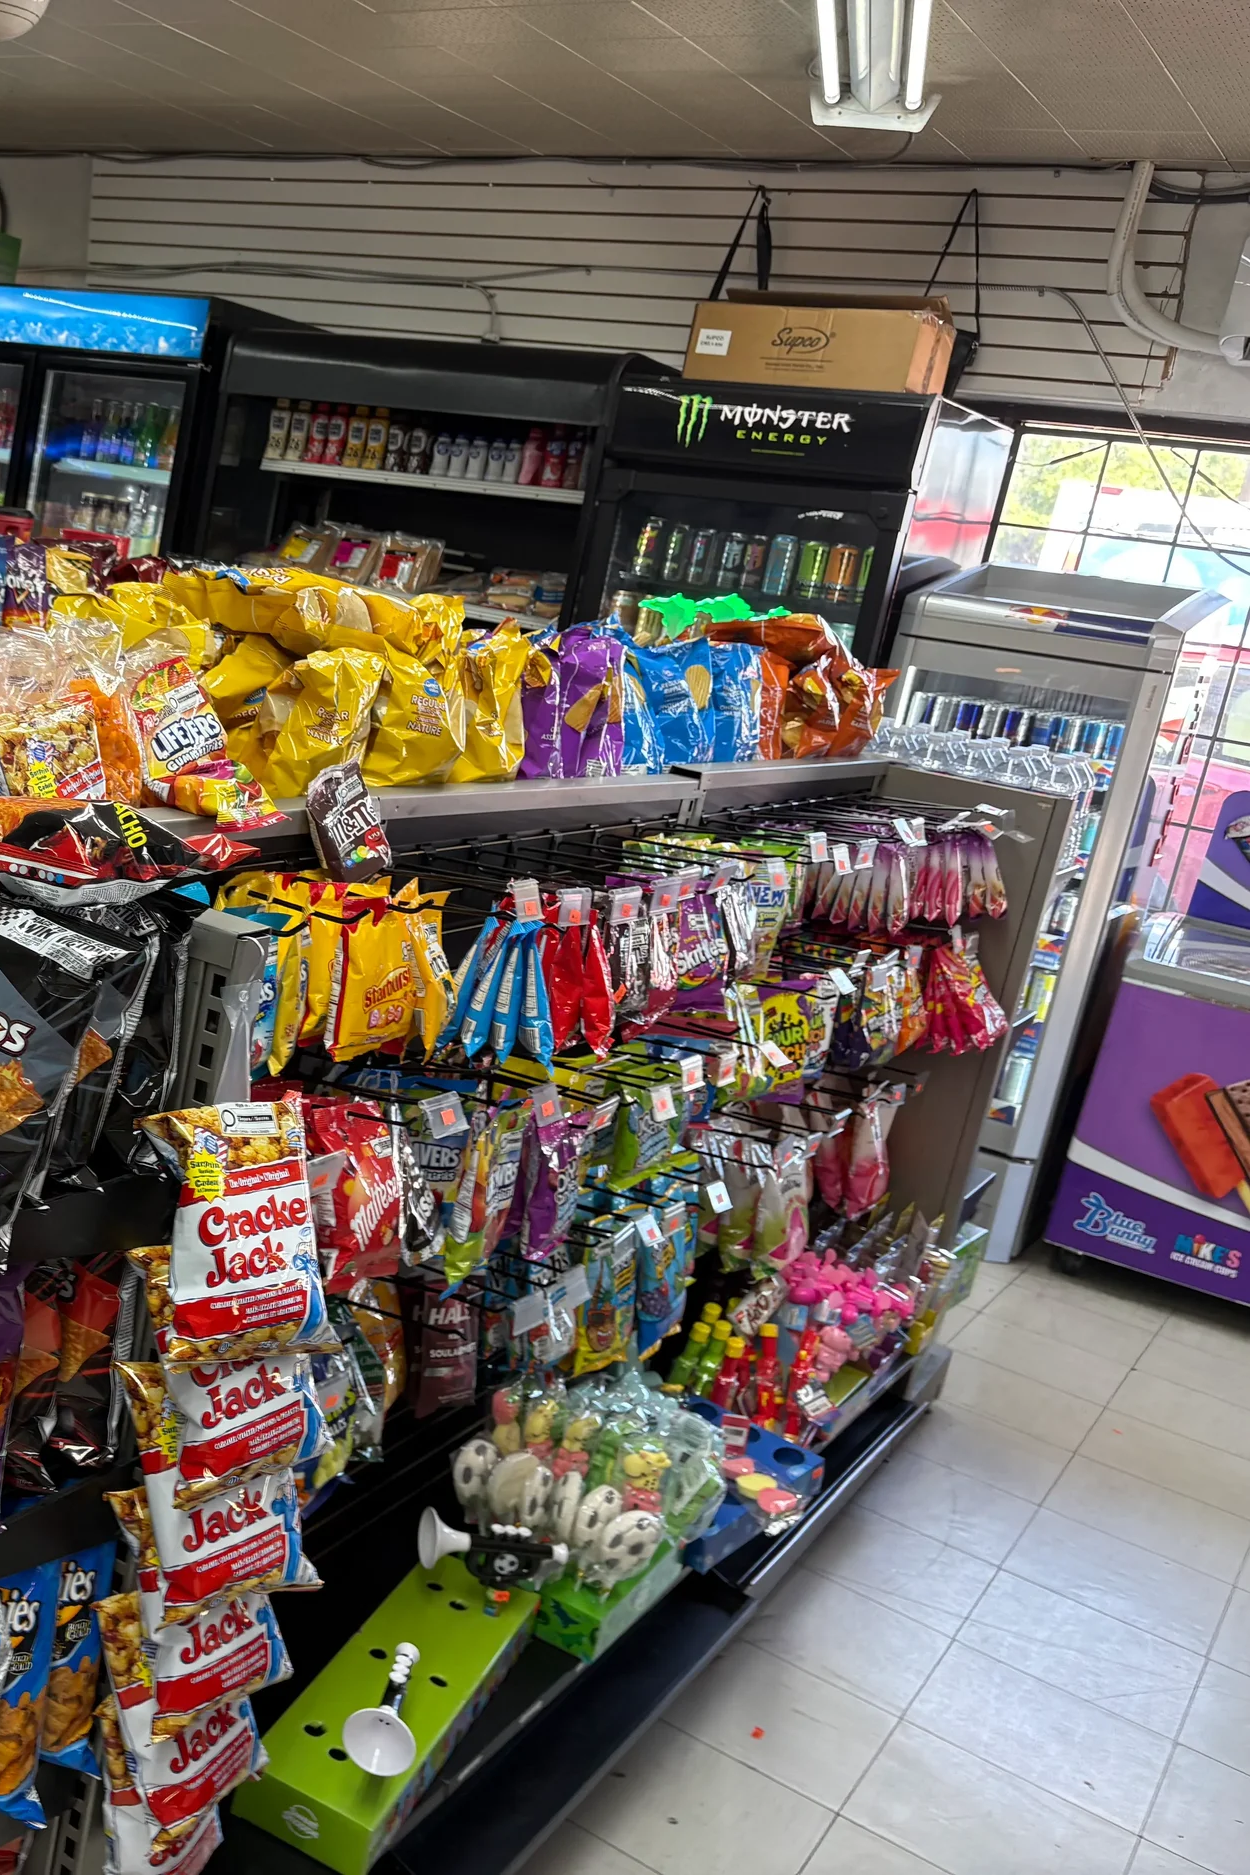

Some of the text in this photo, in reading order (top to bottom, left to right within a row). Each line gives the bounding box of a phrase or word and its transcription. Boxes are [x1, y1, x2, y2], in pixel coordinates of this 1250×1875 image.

[771, 326, 825, 355] Supco
[737, 430, 828, 446] ENERGY
[405, 720, 443, 737] NATURE
[753, 883, 785, 907] NEW
[677, 937, 728, 976] Skittles
[364, 967, 412, 1009] Starburst
[198, 1194, 308, 1248] Cracke
[1074, 1191, 1147, 1236] Blue
[206, 1237, 287, 1289] Jack
[1170, 1251, 1183, 1262] ICE
[1213, 1262, 1239, 1279] CUPS
[201, 1363, 287, 1430] Jack
[183, 1488, 269, 1552] Jack
[180, 1598, 255, 1665] Jack
[169, 1701, 239, 1774] Jack
